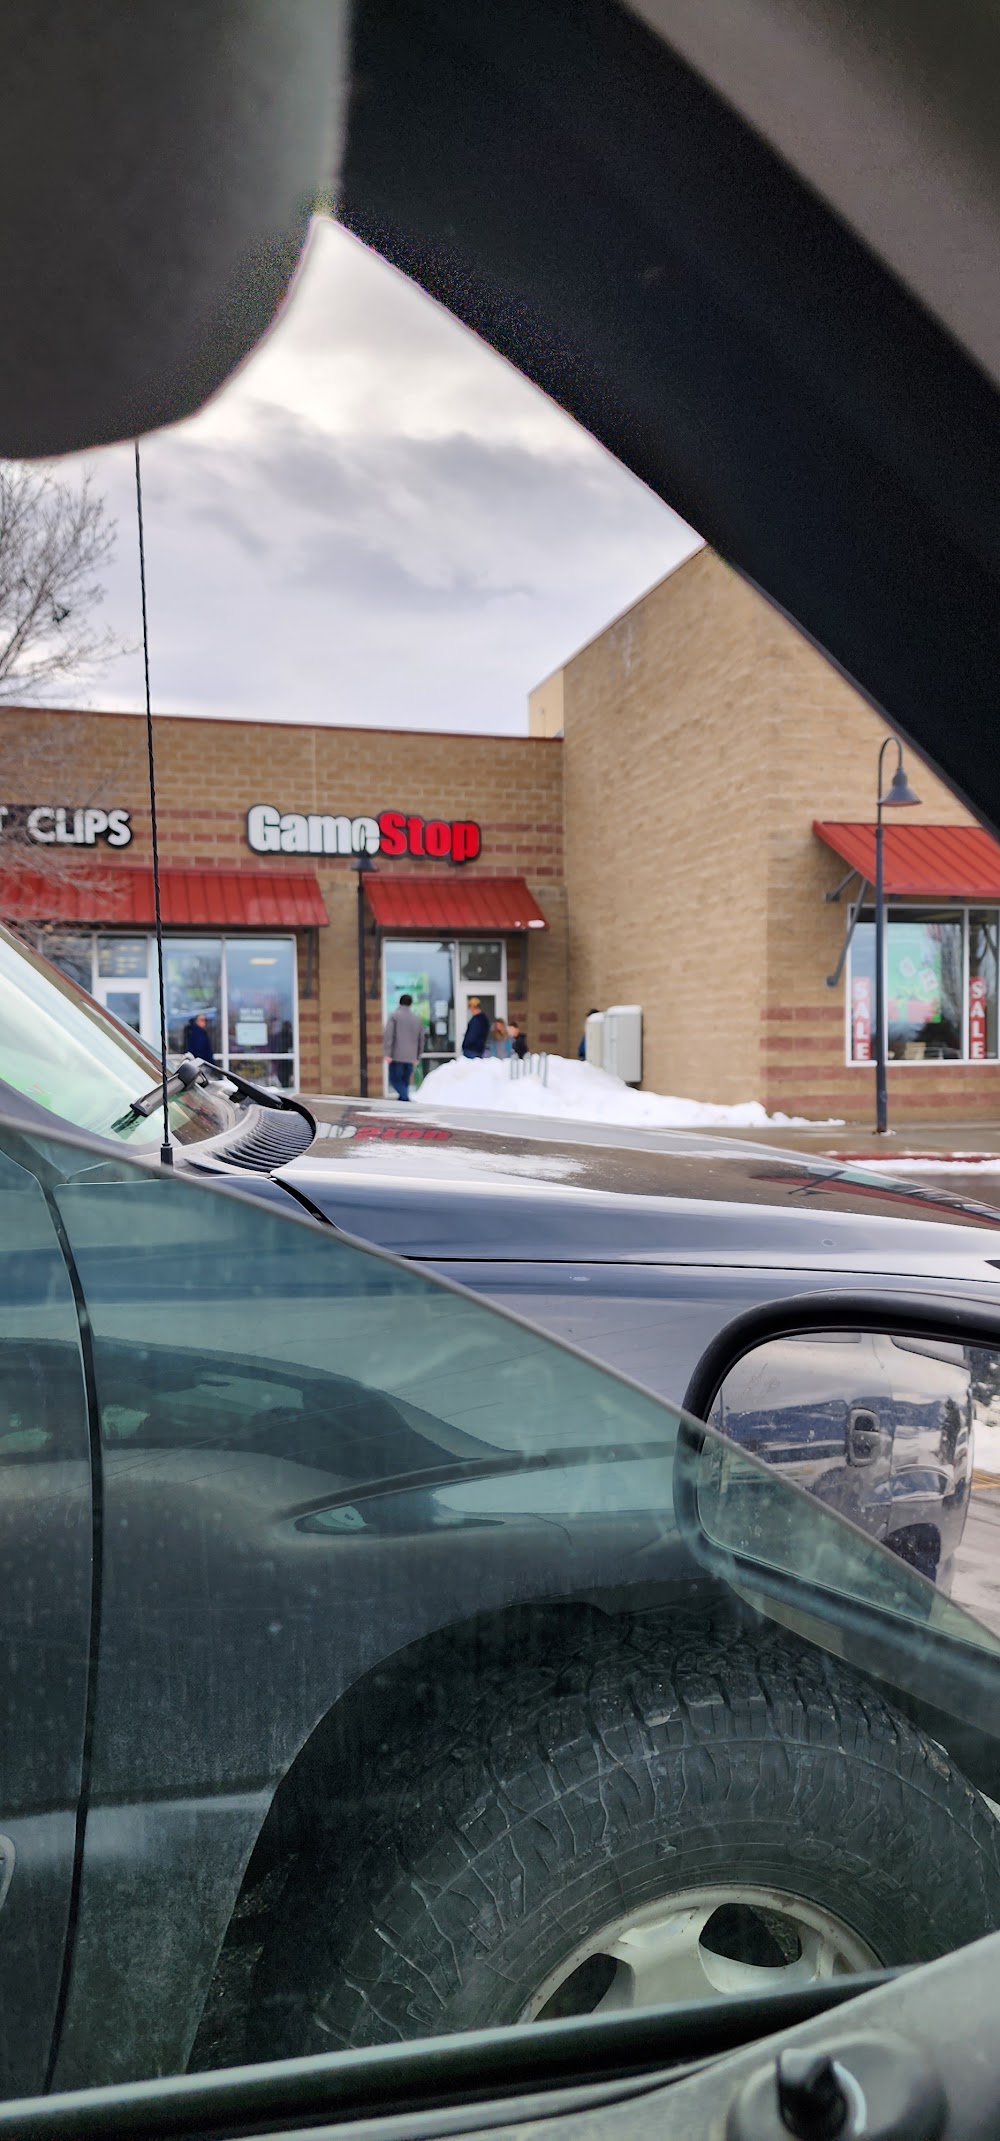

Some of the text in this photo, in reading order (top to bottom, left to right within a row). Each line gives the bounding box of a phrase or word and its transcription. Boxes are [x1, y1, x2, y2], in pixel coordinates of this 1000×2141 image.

[27, 806, 132, 846] CLIPS
[247, 804, 480, 862] GameStop
[854, 982, 871, 1059] SALE
[971, 980, 985, 1058] SALE
